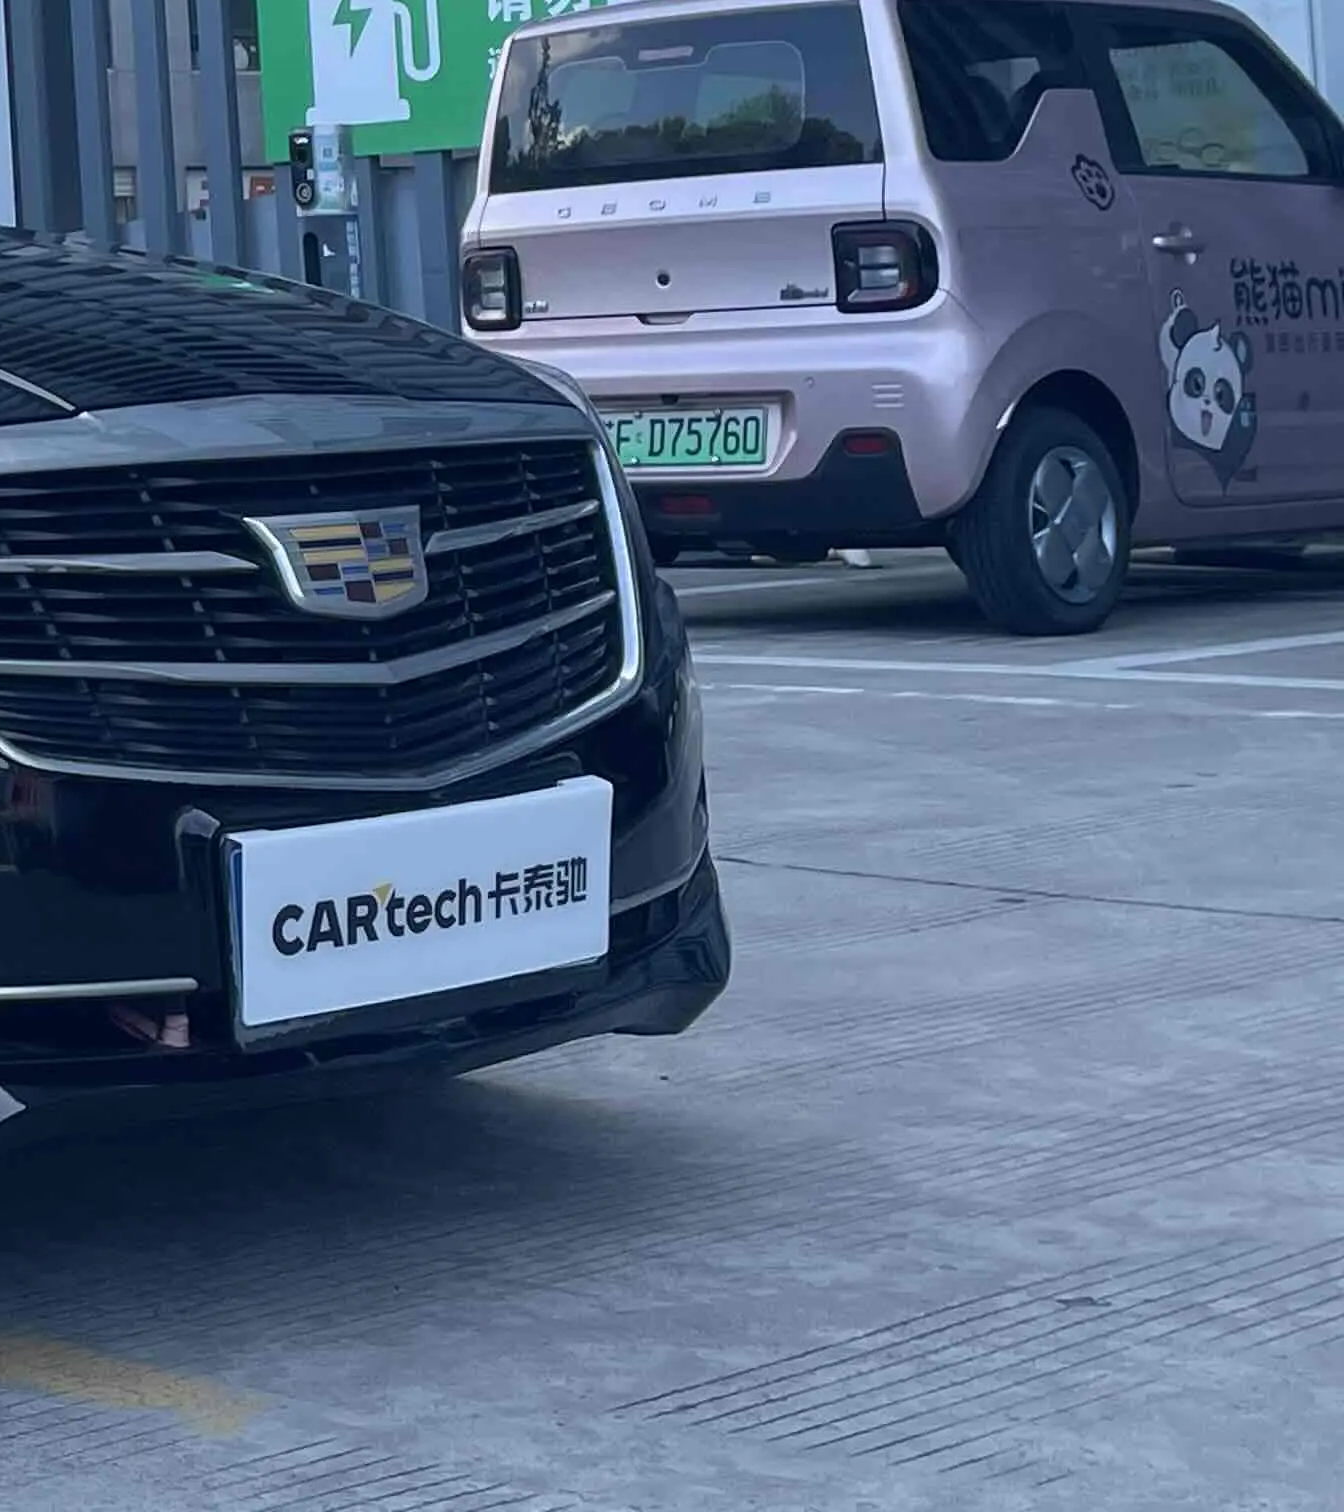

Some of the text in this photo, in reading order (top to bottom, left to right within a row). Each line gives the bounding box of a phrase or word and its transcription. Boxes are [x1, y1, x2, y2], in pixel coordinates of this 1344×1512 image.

[557, 191, 772, 219] GEOME
[648, 415, 761, 457] D75760
[272, 856, 588, 956] CARtech 卡泰驰
